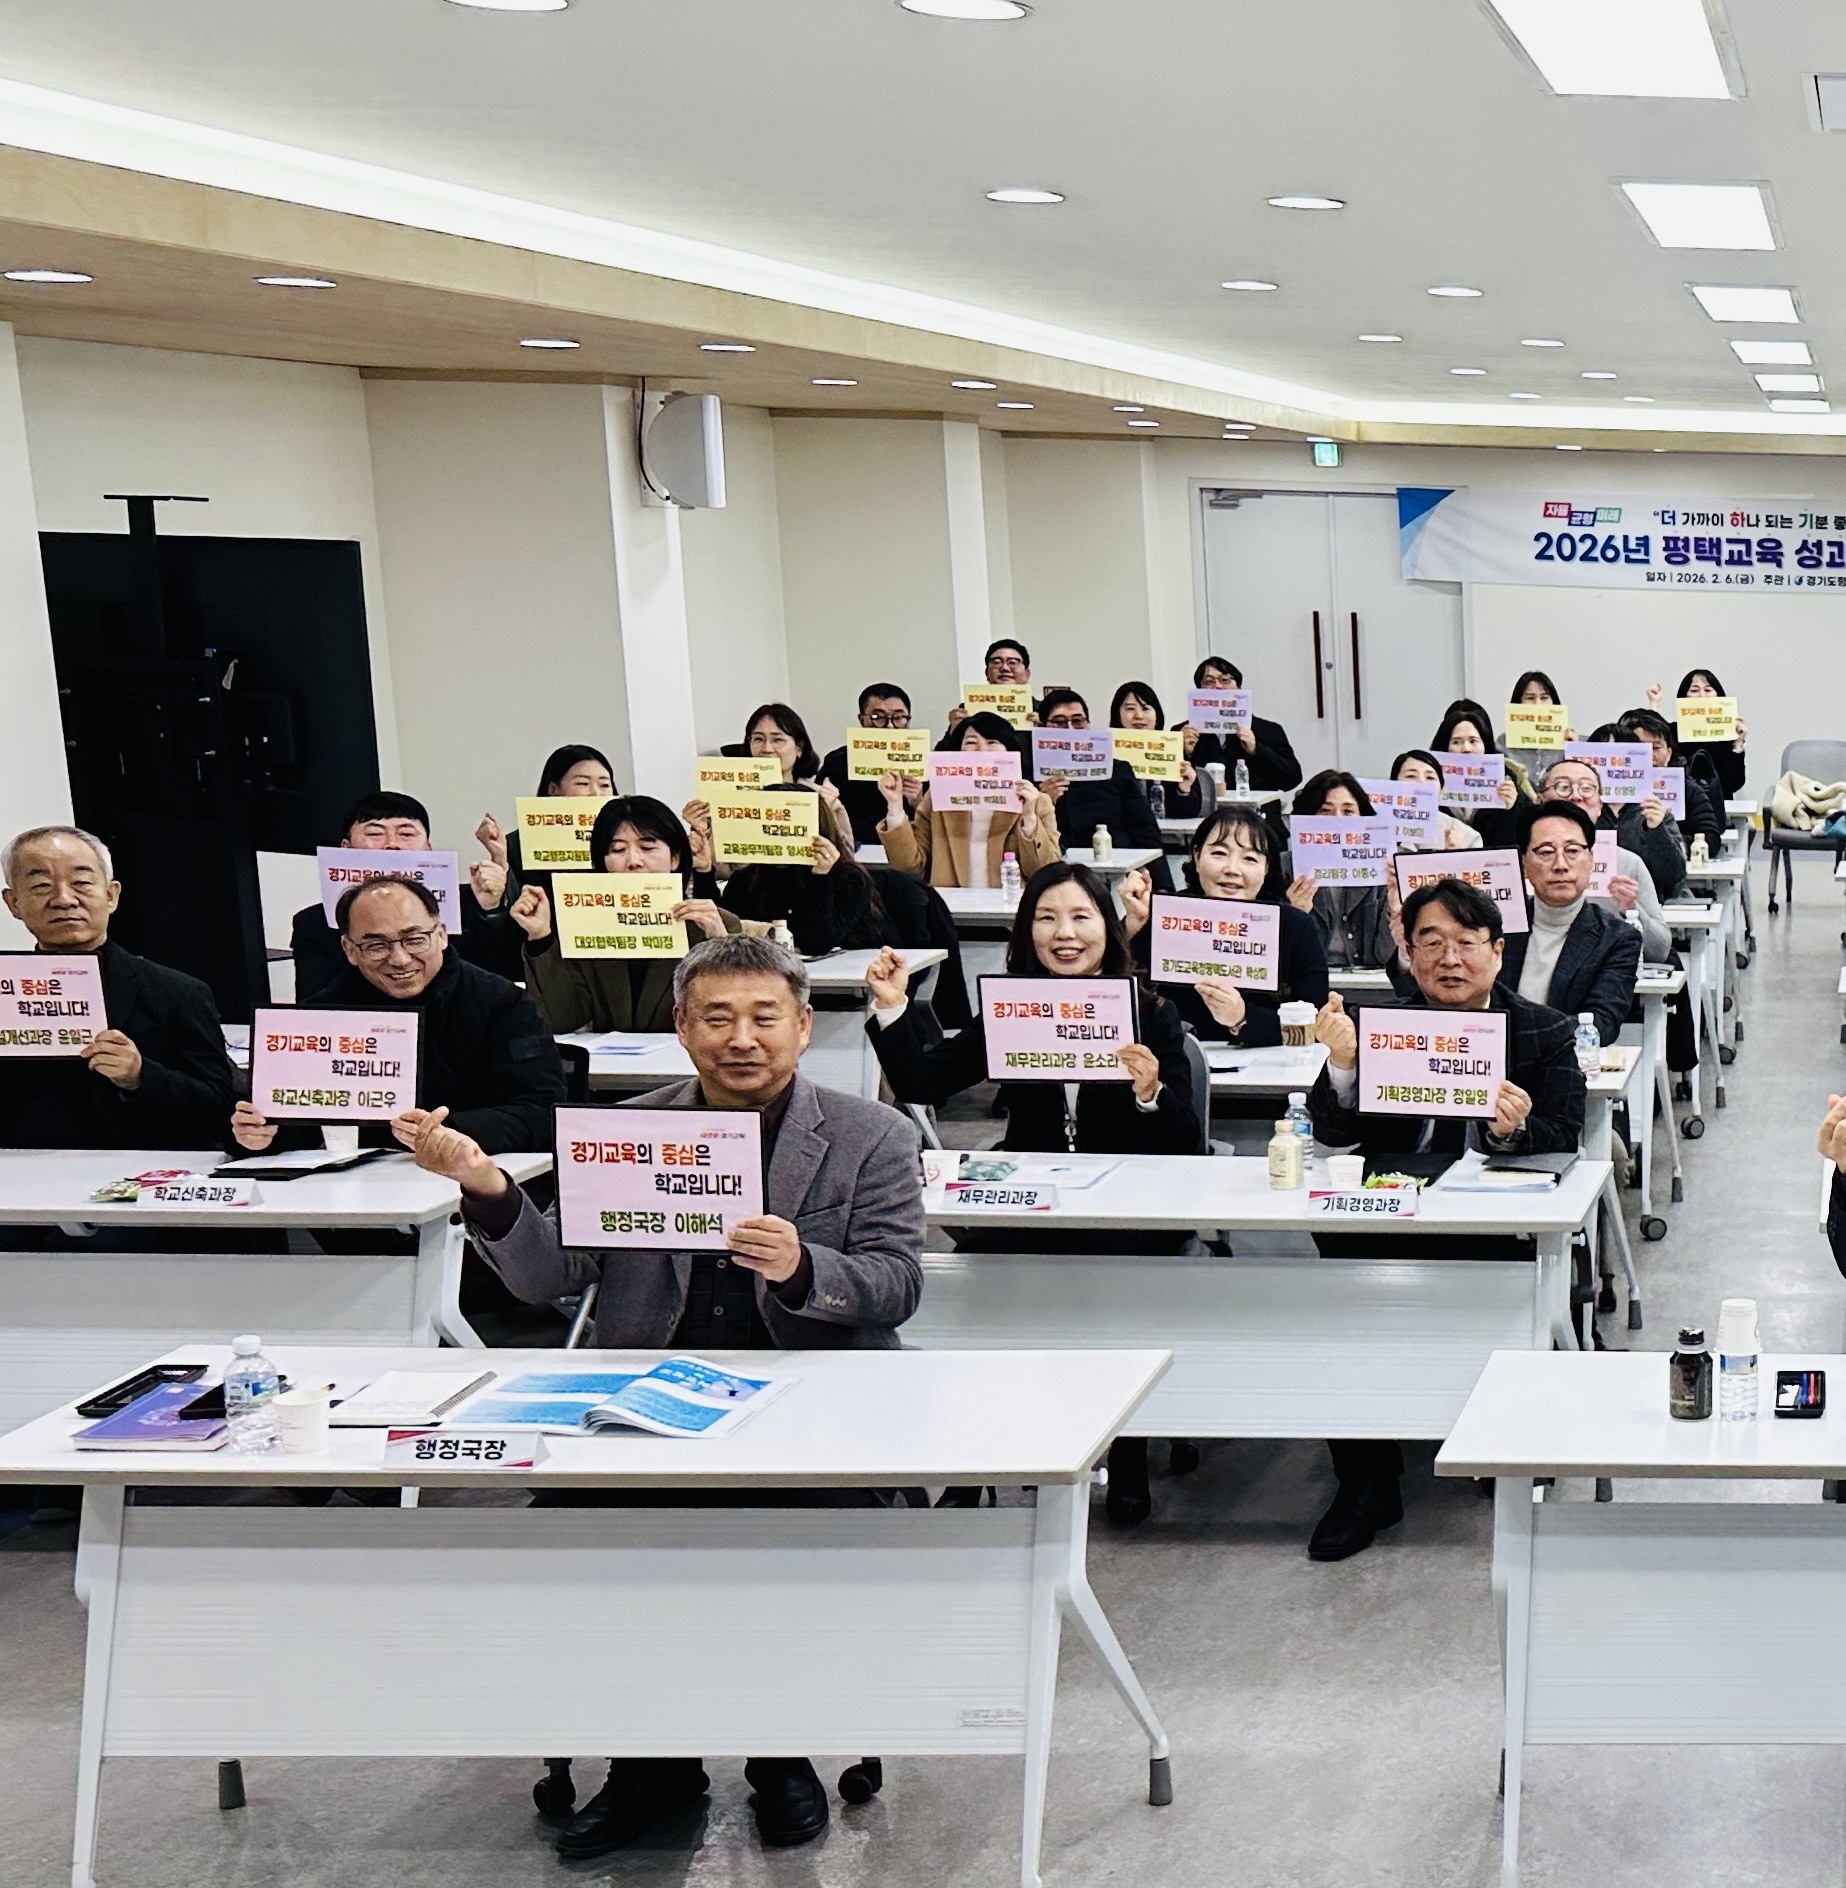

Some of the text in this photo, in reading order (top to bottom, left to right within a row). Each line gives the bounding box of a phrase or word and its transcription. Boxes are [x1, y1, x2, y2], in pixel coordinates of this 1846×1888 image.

[1597, 509, 1621, 522] 미래
[1681, 512, 1724, 527] 가까이
[1730, 511, 1760, 528] 하나
[1765, 514, 1793, 529] 되는
[1799, 513, 1828, 530] 기분
[1533, 532, 1651, 564] 2026년
[1662, 535, 1784, 568] 평택교육
[1646, 571, 1666, 582] 일자
[1677, 573, 1709, 584] 2026.
[1763, 575, 1784, 586] 주관
[853, 740, 910, 751] 경기교육의 중심은
[1038, 740, 1093, 751] 경기교육의 중심은
[1115, 740, 1165, 751] 경기교육의 중심은
[1610, 756, 1631, 766] 중심은
[700, 771, 734, 782] 경기교육의
[936, 767, 972, 776] 경기교육의
[977, 767, 998, 776] 중심은
[1397, 795, 1417, 807] 중심은
[526, 814, 573, 826] 경기교육의
[718, 807, 791, 821] 경기교육의 중심은
[1298, 832, 1370, 844] 경기교육의 중심은
[1342, 848, 1387, 859] 학교입니다!
[1462, 871, 1491, 884] 중심은
[563, 894, 651, 908] 경기교육의 중심은
[617, 912, 672, 925] 학교입니다!
[1161, 916, 1248, 937] 경기교육의 중심은
[1213, 939, 1266, 956] 학교입니다!
[21, 979, 62, 996] 중심은
[17, 1001, 90, 1016] 학교입니다!
[993, 1003, 1095, 1019] 경기교육의 중심은
[1055, 1024, 1119, 1040] 학교입니다!
[266, 1035, 377, 1054] 경기교육의 중심은
[1370, 1033, 1470, 1054] 경기교육의 중심은
[1005, 1052, 1076, 1068] 재무관리과장
[1428, 1058, 1491, 1076] 학교입니다!
[332, 1060, 401, 1077] 학교입니다!
[272, 1089, 396, 1108] 학교신축과장 이근우
[1376, 1085, 1488, 1105] 기획경영과장 정일영
[571, 1141, 711, 1166] 경기교육의 중심은
[654, 1172, 742, 1196] 학교입니다!
[154, 1186, 236, 1201] 학교신축과장
[958, 1190, 1037, 1205] 재무관리과장
[1323, 1197, 1400, 1212] 기획경영과장
[600, 1211, 723, 1235] 행정국장 이해석
[415, 1439, 507, 1460] 행정국장
